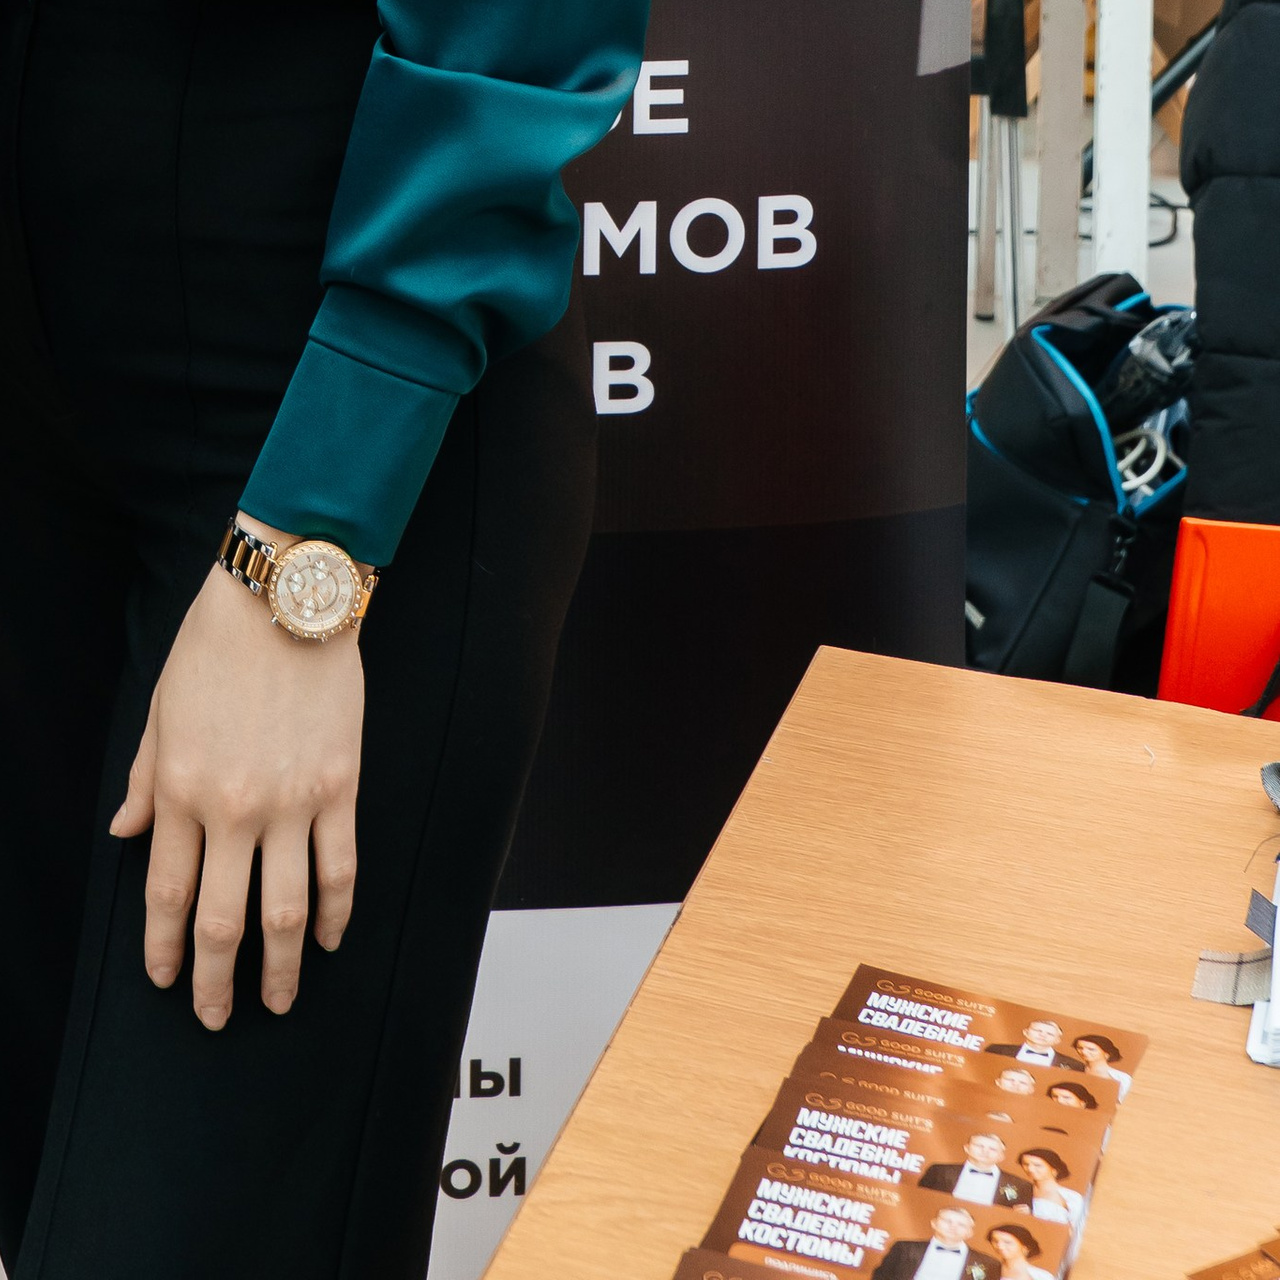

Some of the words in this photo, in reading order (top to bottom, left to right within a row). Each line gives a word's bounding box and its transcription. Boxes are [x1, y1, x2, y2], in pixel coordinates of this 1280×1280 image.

[583, 194, 817, 276] МОВ
[866, 991, 973, 1031] МУЖСКИЕ
[914, 988, 954, 1003] GOOD
[858, 1008, 985, 1052] СВАДЕБНЫЕ
[880, 1039, 921, 1054] GOOD
[453, 1057, 521, 1099] ы
[796, 1107, 910, 1149] МУЖСКИЕ
[845, 1100, 887, 1117] GOOD
[789, 1127, 925, 1173] СВАДЕБНЫЕ
[756, 1178, 876, 1224] МУЖСКИЕ
[738, 1218, 865, 1268] КОСТЮМЫ
[747, 1199, 890, 1251] СВАДЕБНЫЕ
